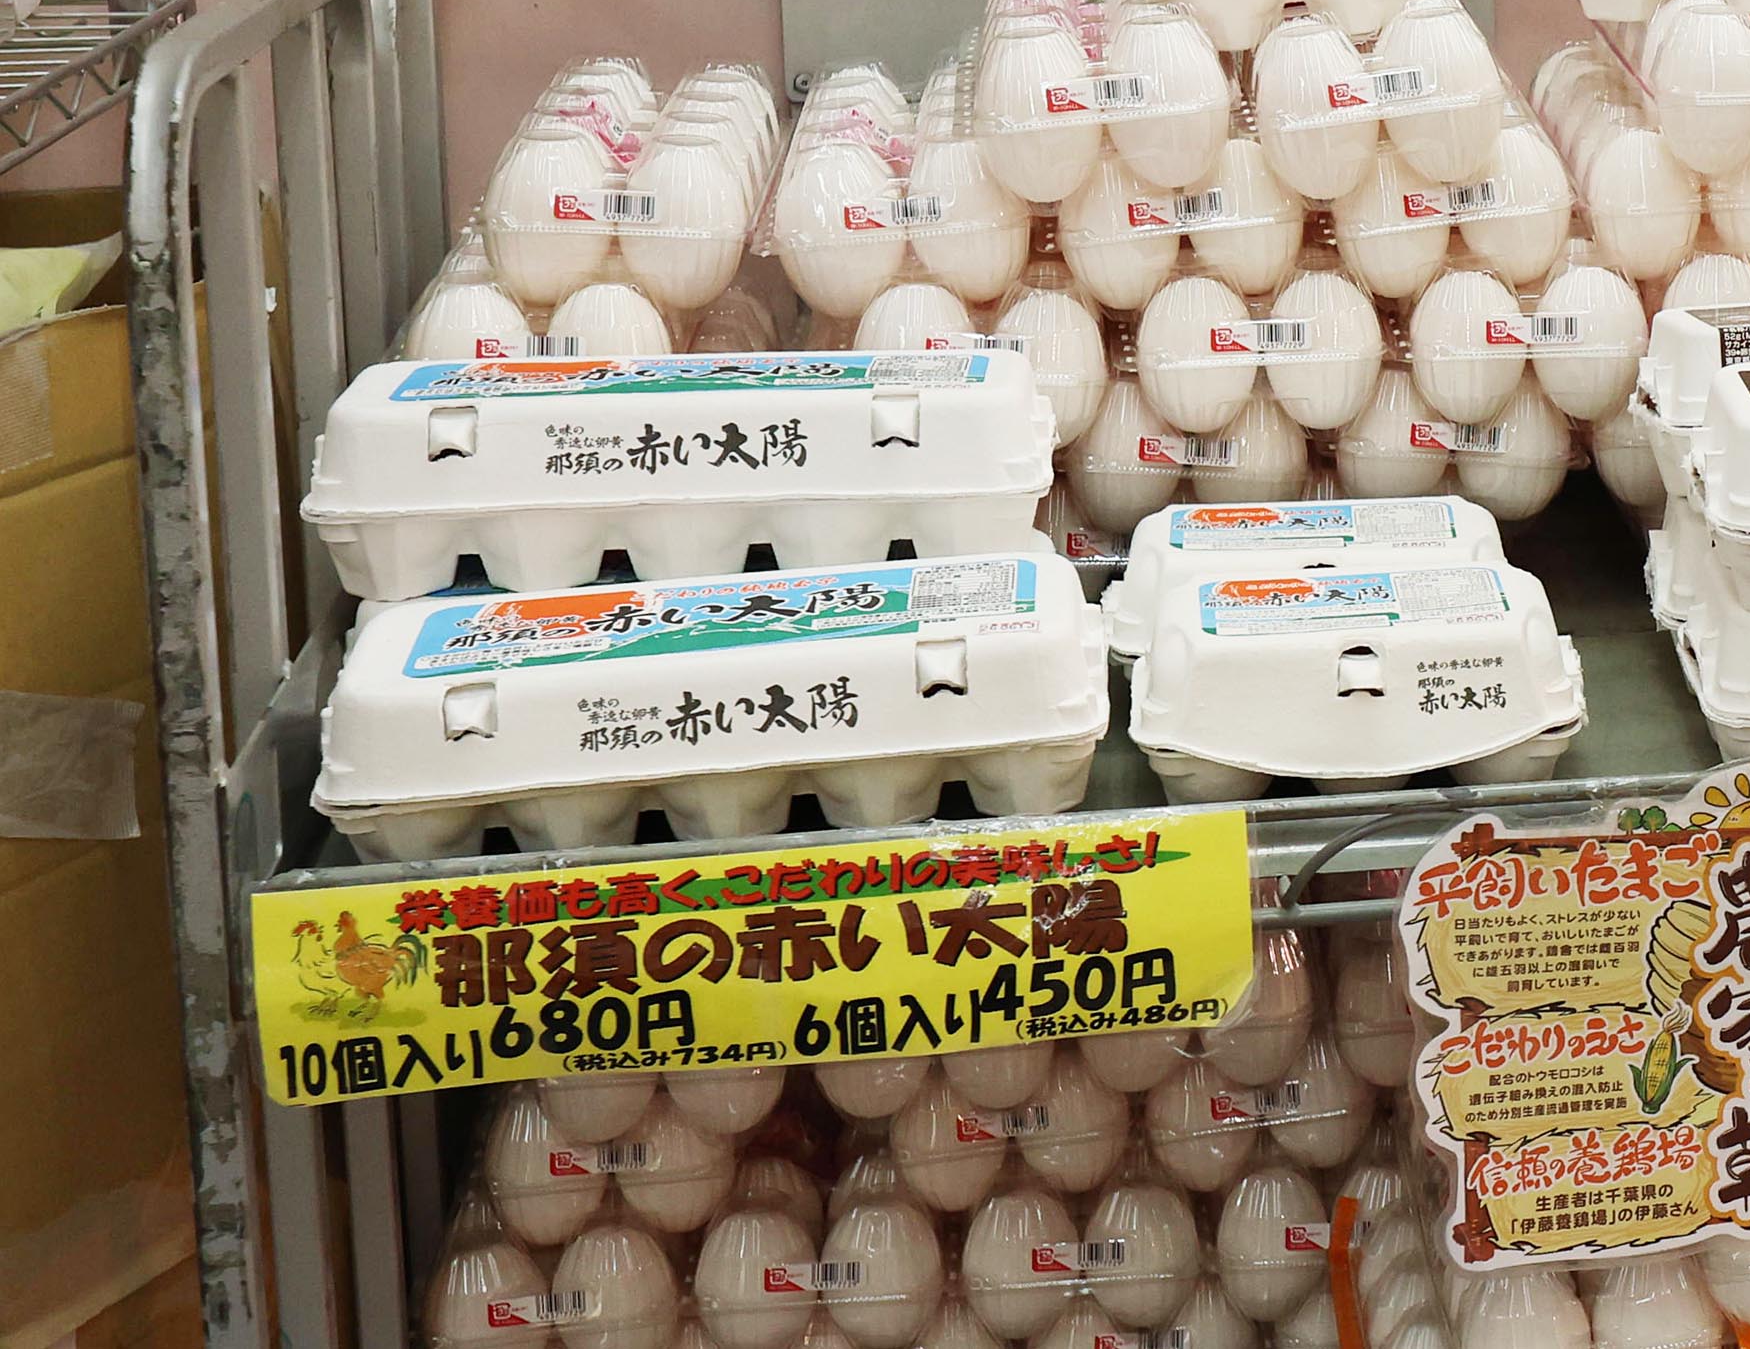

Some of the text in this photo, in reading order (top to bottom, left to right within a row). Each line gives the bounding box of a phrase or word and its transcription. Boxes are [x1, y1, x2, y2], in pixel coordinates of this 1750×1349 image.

[1419, 683, 1507, 715] 赤い太陽
[1416, 830, 1721, 918] 平飼いたまご
[1454, 910, 1640, 930] 日当たりもよく、ストレスが少ない
[433, 881, 1130, 1007] 那須の赤い太陽
[1454, 925, 1639, 946] 平飼いで育て、おいしいたまごが
[1507, 975, 1600, 992] 飼育しています。
[1439, 1016, 1646, 1075] こだわりのえさ
[1489, 1065, 1604, 1086] 配合のトウモロコシは
[1469, 1081, 1623, 1106] 遺伝子組み換えの混入防止
[1467, 1126, 1702, 1199] 信頼の養鶏場
[1535, 1184, 1674, 1212] 生産者は千葉県の
[1511, 1201, 1698, 1235] 「伊藤養鶏場」の伊藤さん
